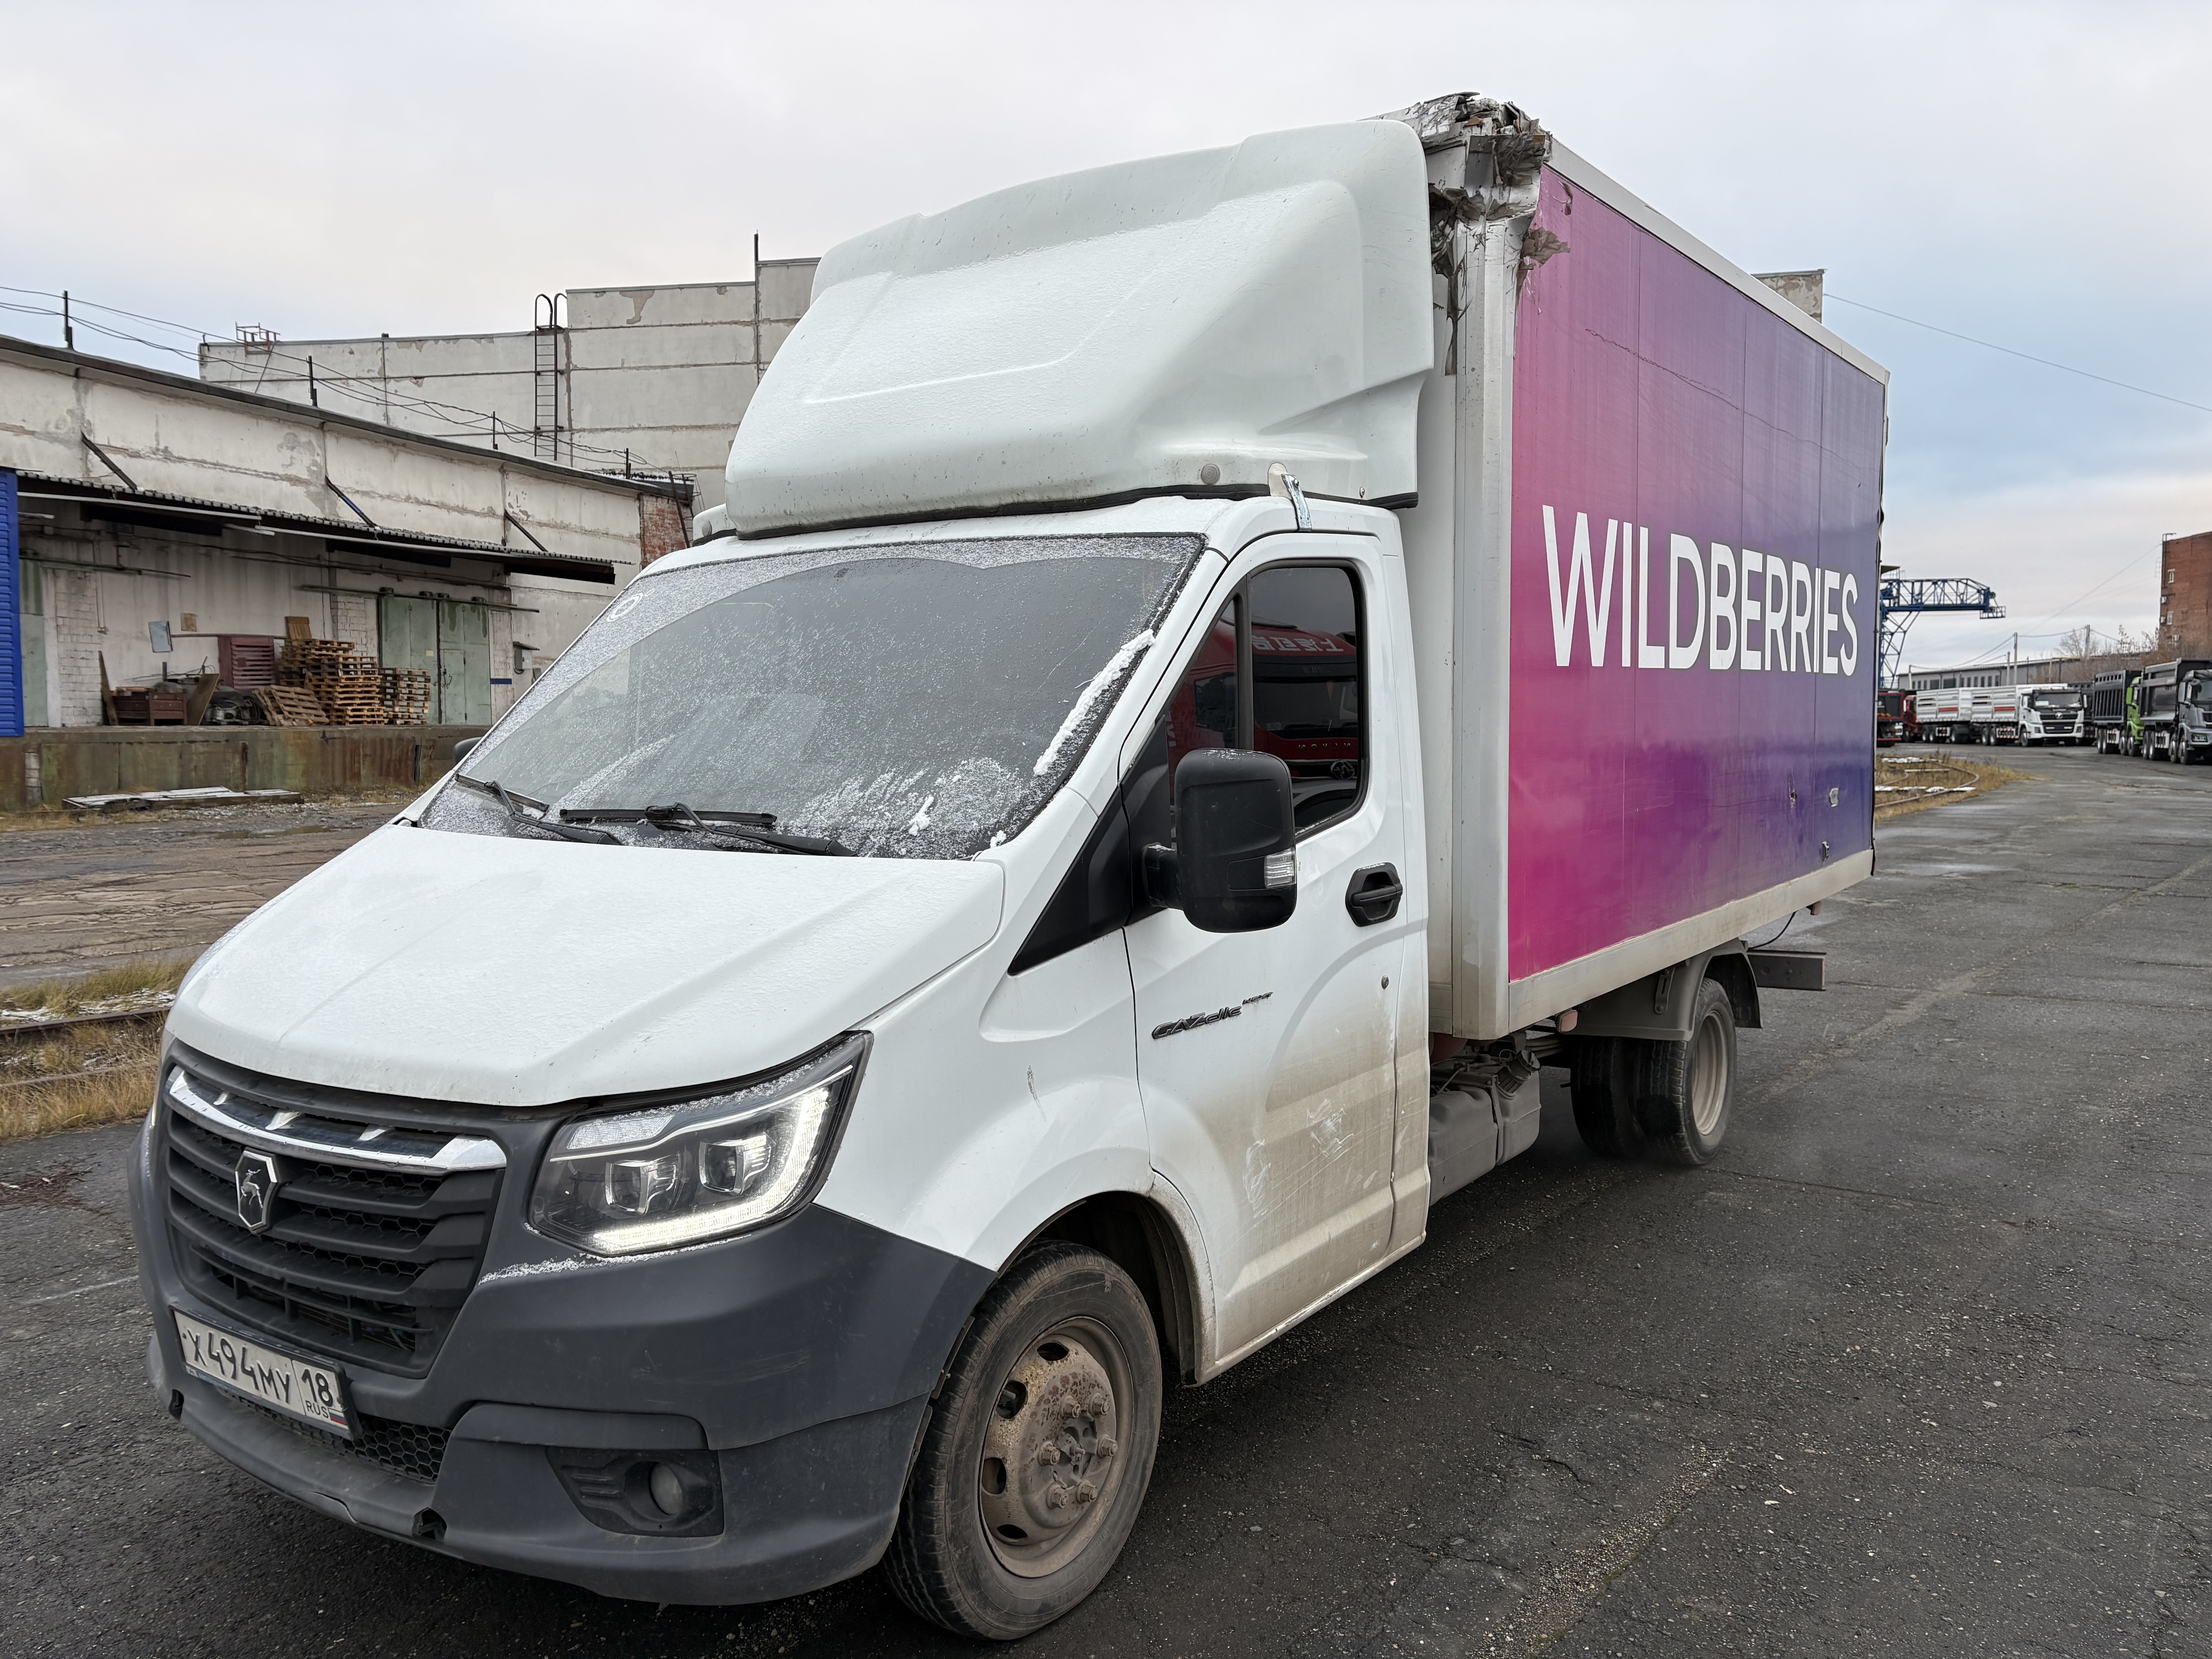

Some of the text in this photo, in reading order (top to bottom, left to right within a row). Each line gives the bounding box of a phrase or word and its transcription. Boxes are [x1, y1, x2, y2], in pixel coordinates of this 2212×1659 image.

[1542, 505, 1857, 676] WILDBERRIES
[301, 1368, 333, 1407] 18
[306, 1400, 329, 1419] RUS
